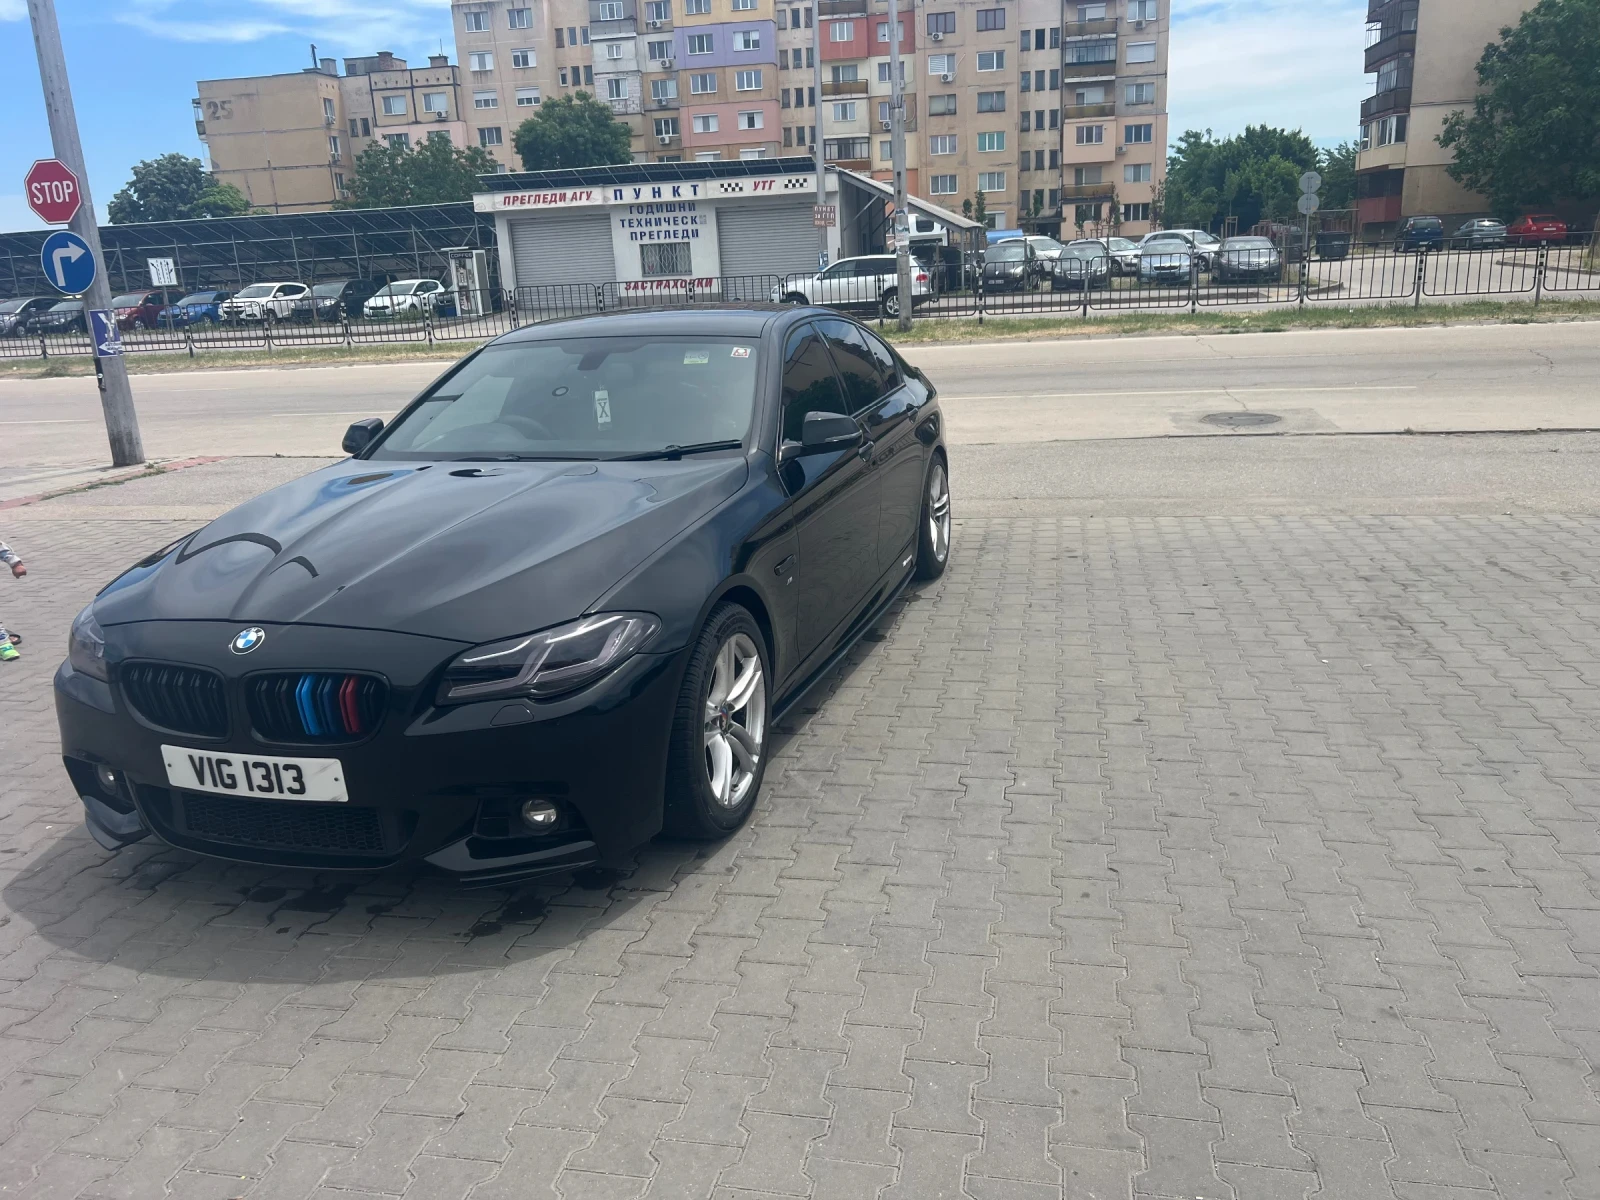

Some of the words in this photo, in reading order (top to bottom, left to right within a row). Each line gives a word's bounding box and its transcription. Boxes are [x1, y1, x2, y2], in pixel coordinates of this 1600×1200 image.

[31, 180, 74, 205] STOP
[613, 184, 699, 201] ПУНКТ
[753, 180, 776, 192] УТГ
[503, 192, 567, 206] ПРЕГЛЕДИ
[570, 190, 593, 202] АГУ
[629, 202, 696, 215] ГОДИШНИ
[630, 229, 699, 240] ПРЕГЛЕДИ
[624, 278, 713, 291] ЗАСТРАХОКИ
[187, 754, 238, 790] VIG
[242, 760, 306, 795] 1313
